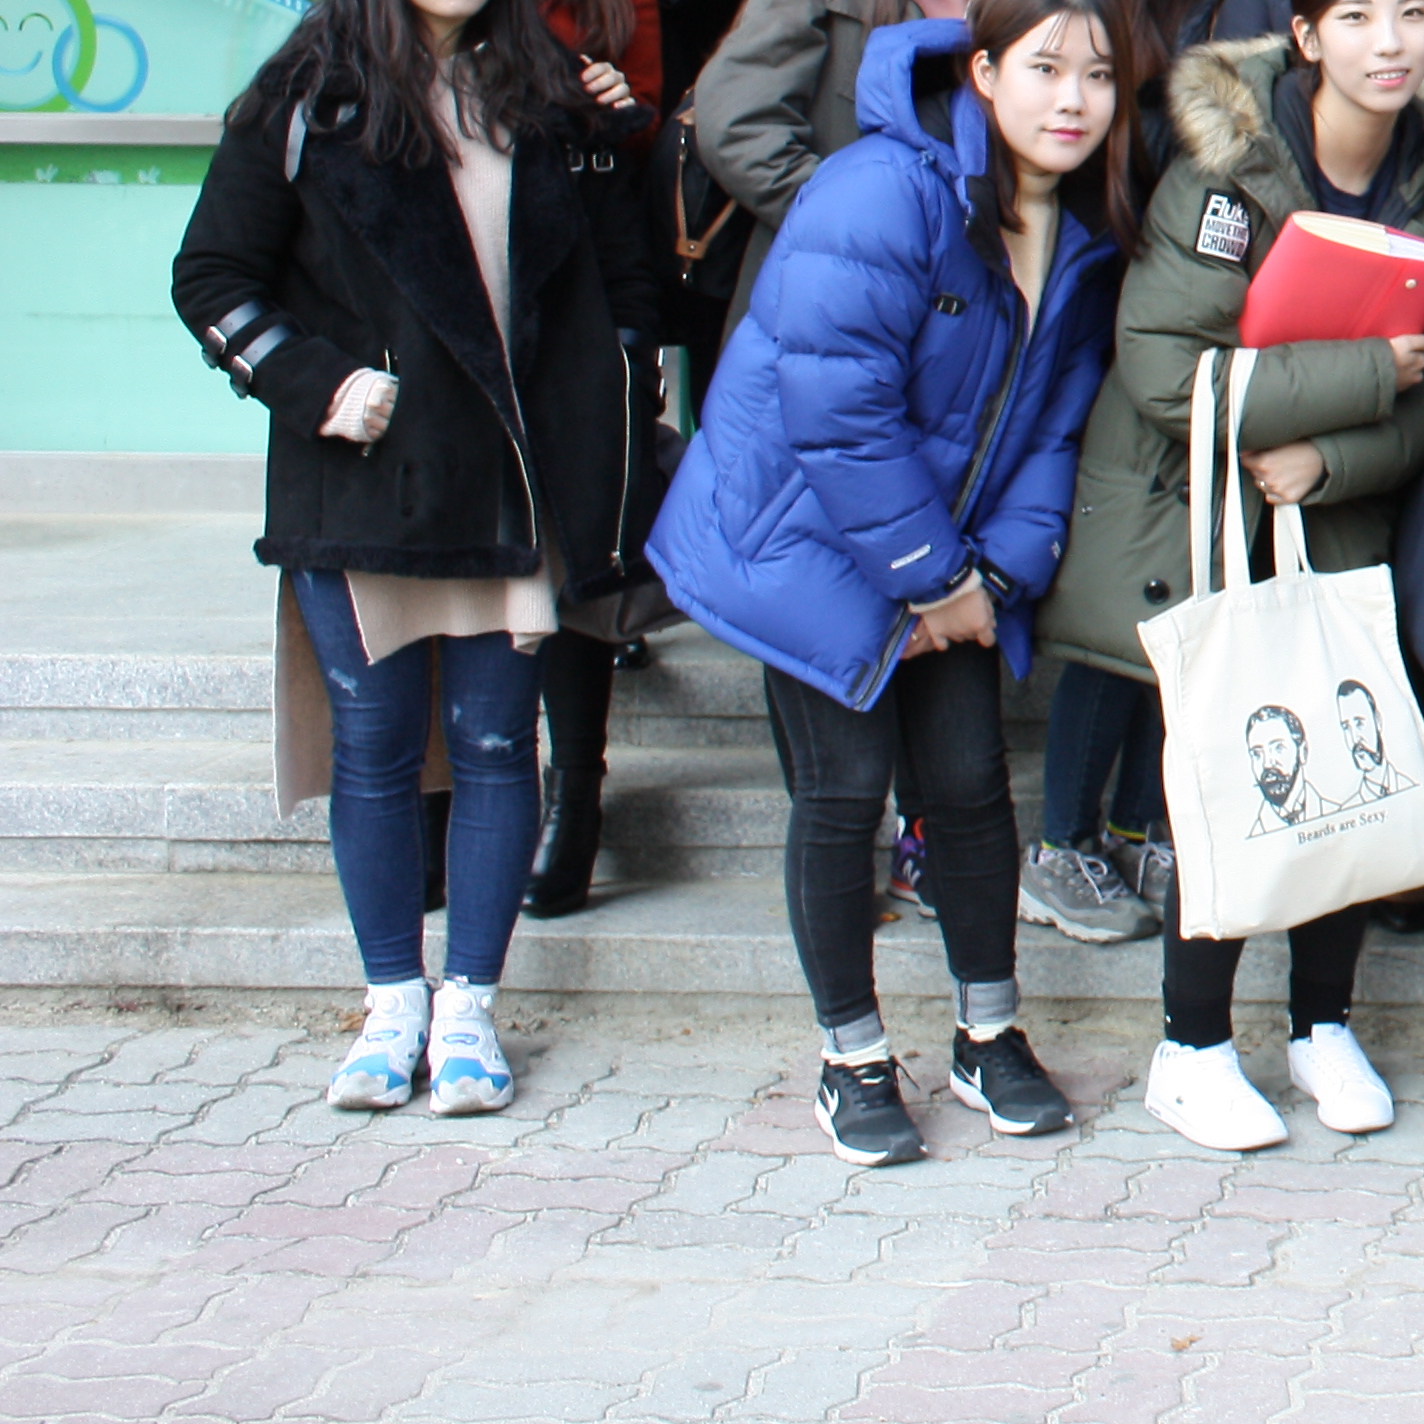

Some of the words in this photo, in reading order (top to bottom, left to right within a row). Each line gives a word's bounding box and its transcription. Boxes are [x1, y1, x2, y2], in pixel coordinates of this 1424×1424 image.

[1297, 823, 1336, 845] Beards
[1339, 819, 1357, 832] are
[1358, 810, 1388, 826] Sexy
